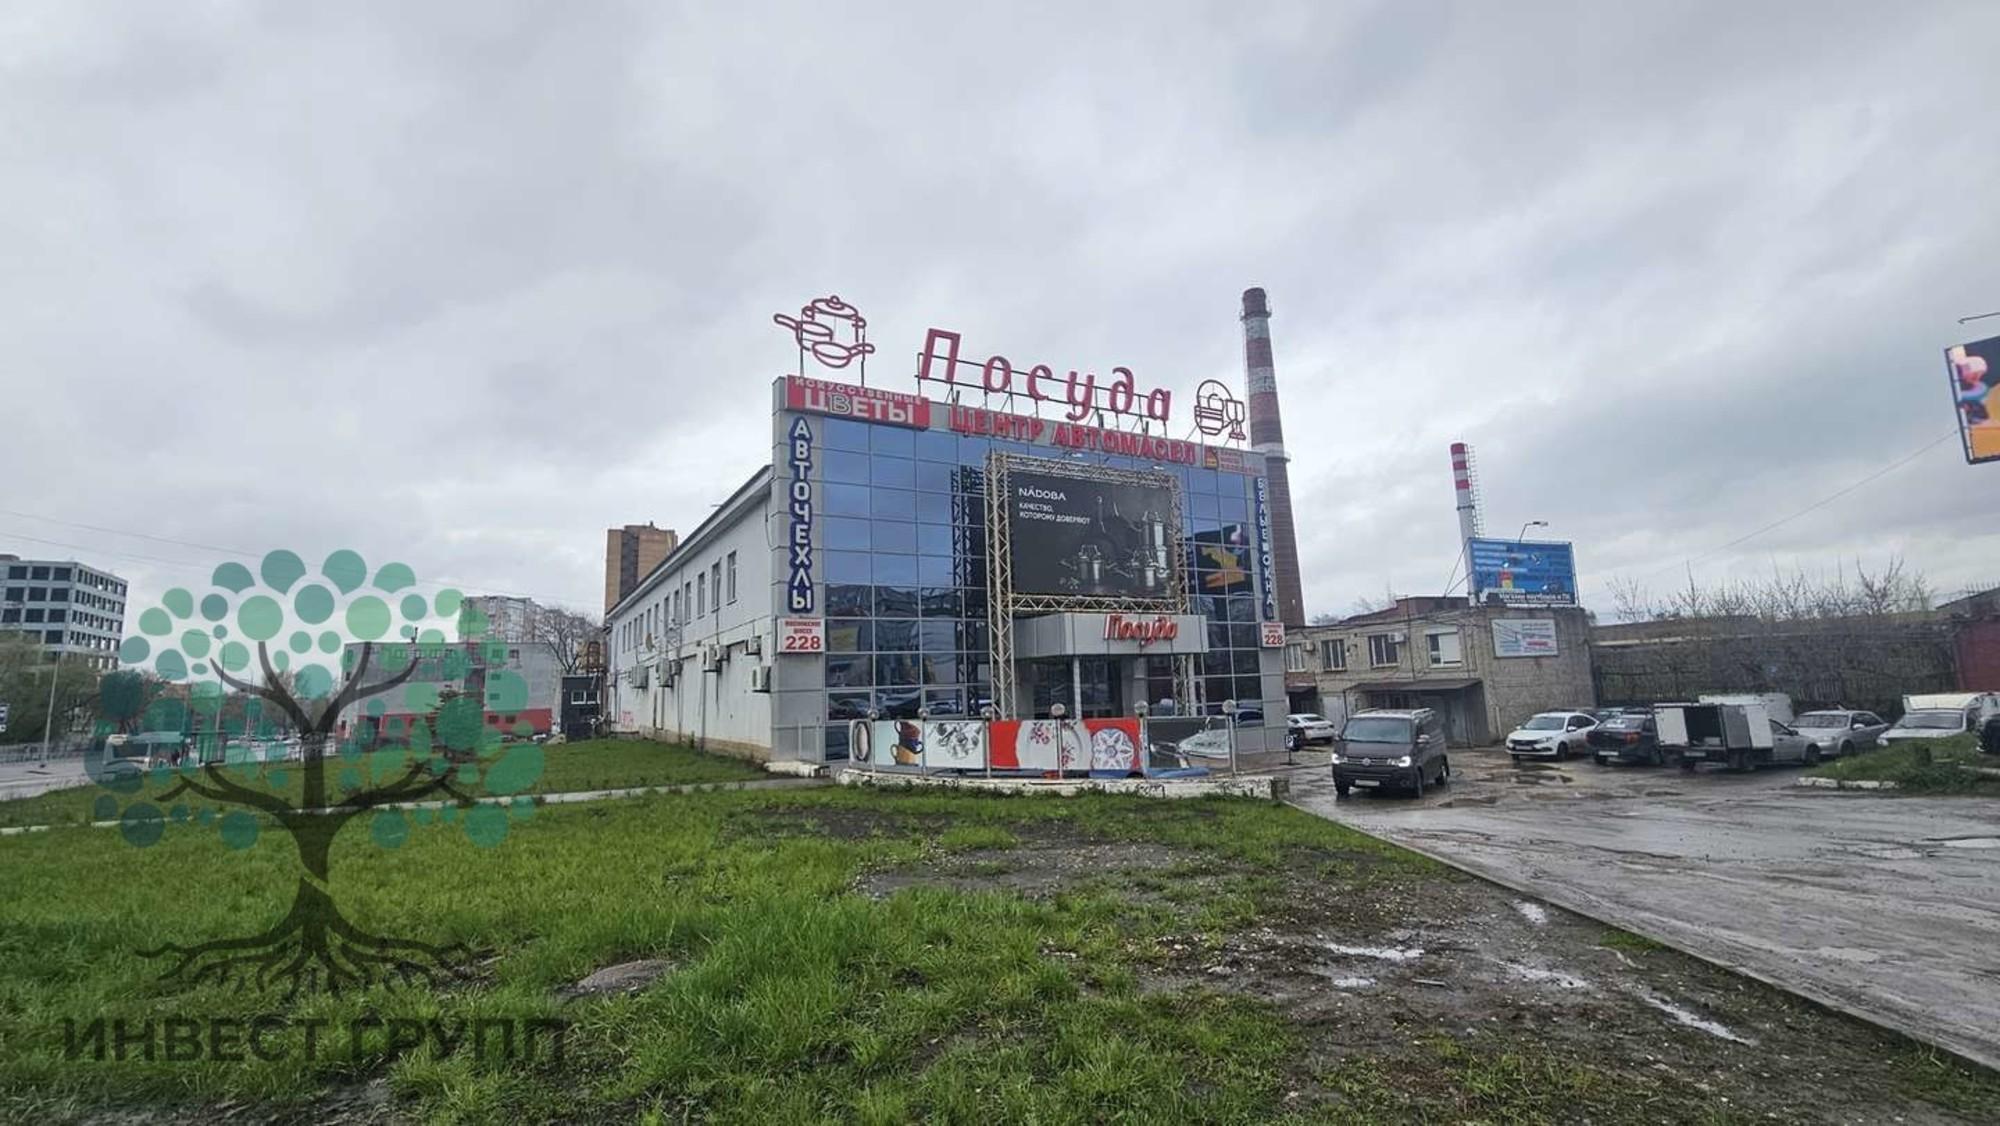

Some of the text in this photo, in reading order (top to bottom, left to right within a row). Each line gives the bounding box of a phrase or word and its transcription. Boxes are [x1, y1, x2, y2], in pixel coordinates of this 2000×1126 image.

[921, 328, 1171, 421] Посуда
[805, 388, 914, 424] ЦВЕТЫ
[950, 406, 1197, 465] ЦЕНТР АВТОМАСЕЛ
[791, 418, 813, 610] АВТОЧЕХЛЫ
[785, 636, 821, 650] 228
[1104, 613, 1178, 646] Посуда
[1264, 634, 1284, 645] 228
